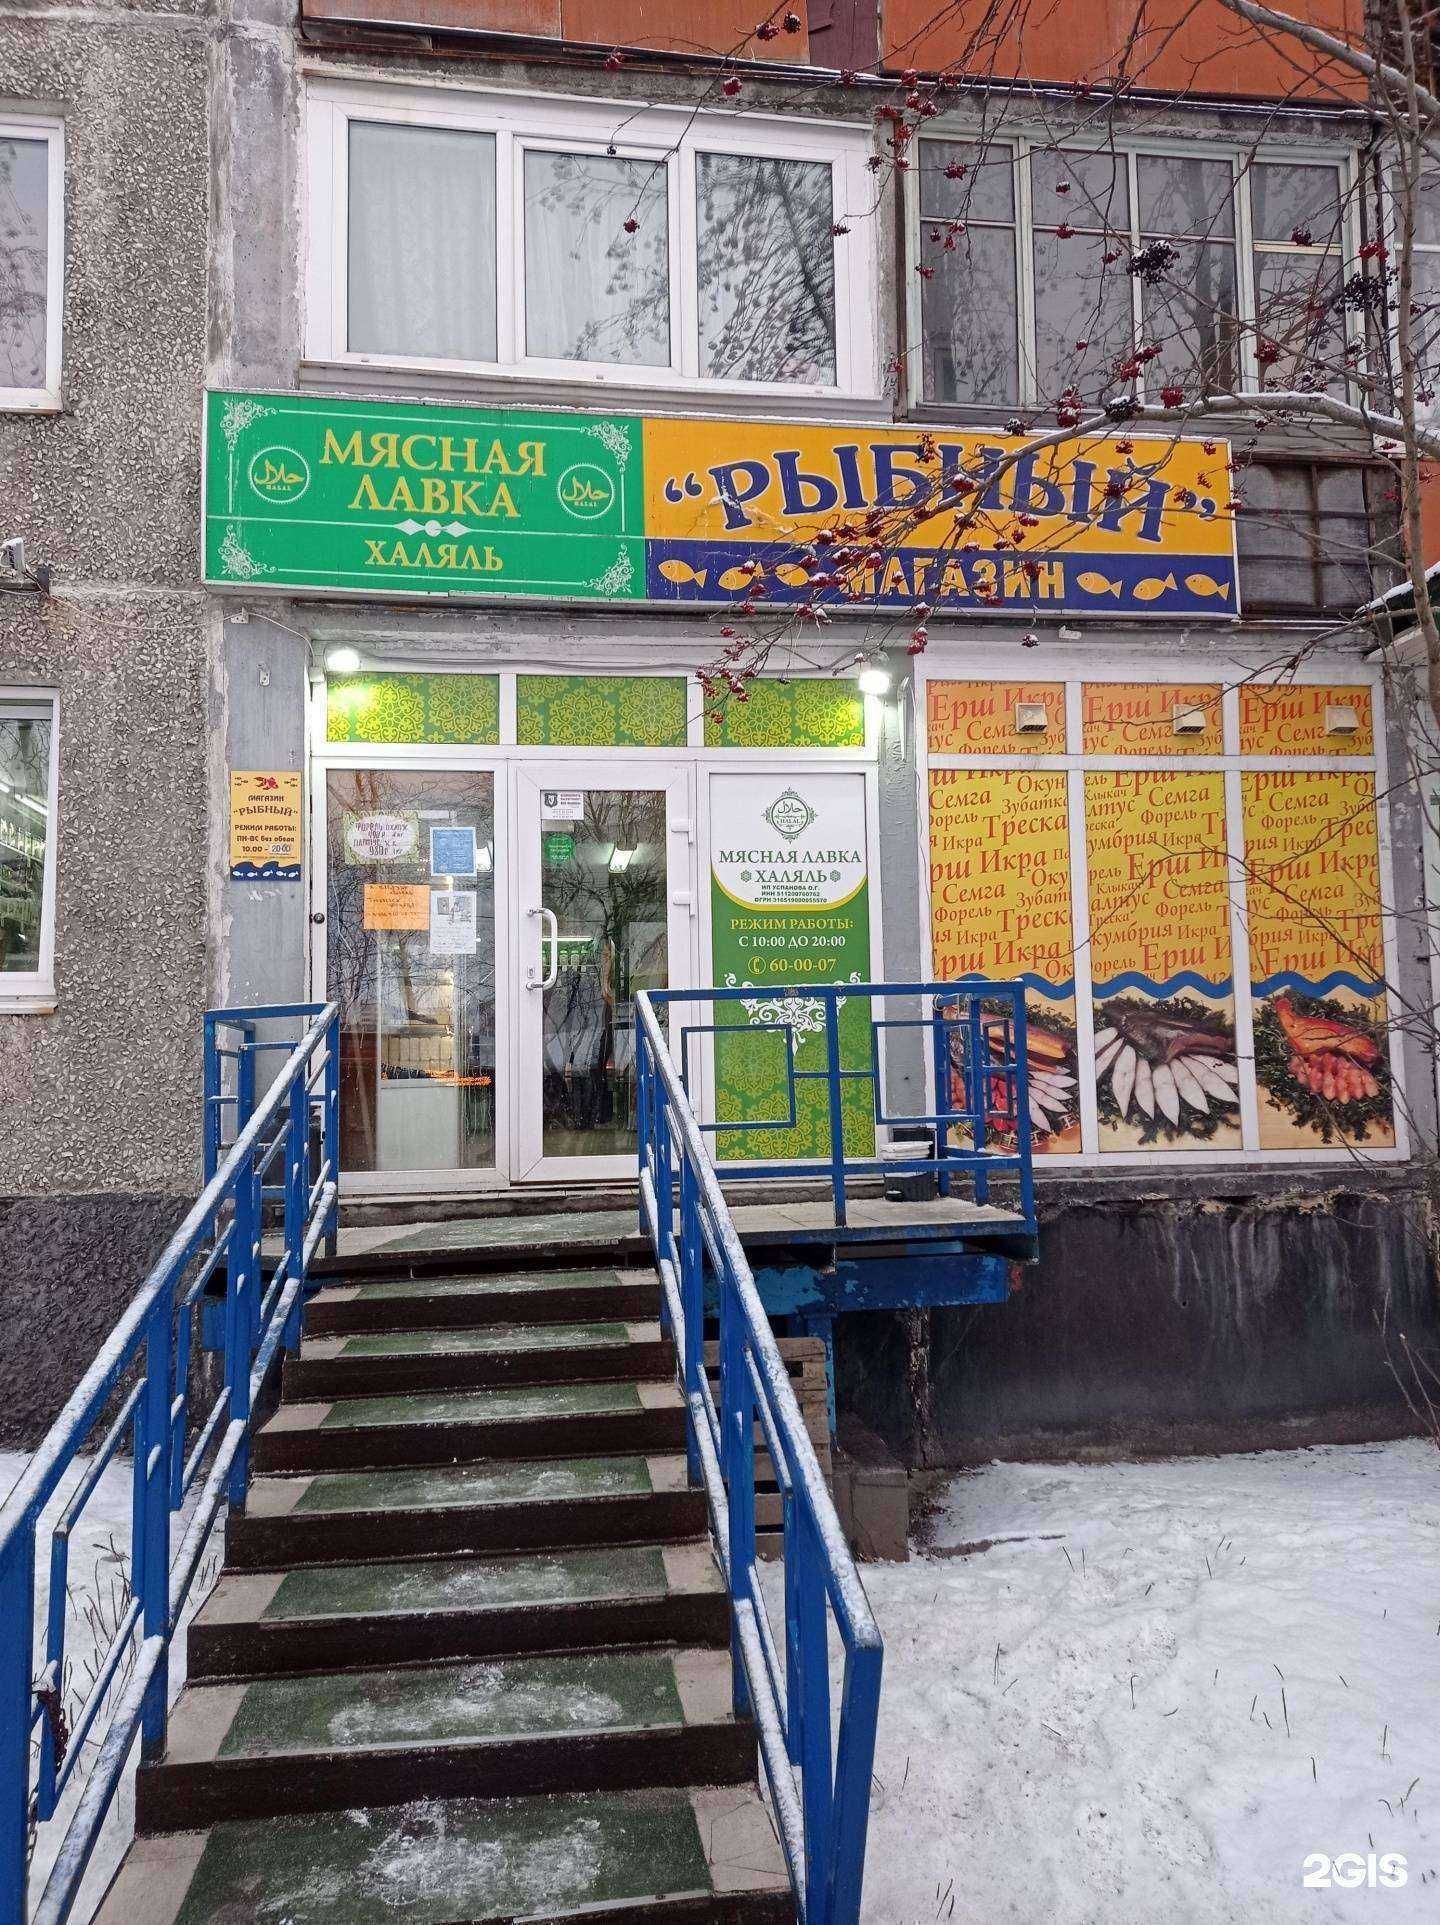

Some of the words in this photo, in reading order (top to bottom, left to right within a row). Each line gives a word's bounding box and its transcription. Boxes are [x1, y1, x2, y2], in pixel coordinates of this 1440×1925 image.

[319, 428, 547, 477] МЯСНАЯ
[347, 473, 522, 518] ЛАВКА
[364, 539, 504, 572] ХАЛЯЛЬ
[931, 694, 997, 731] Ерш
[1086, 696, 1152, 733] Ерш
[1242, 697, 1305, 733] Ерш
[967, 720, 1017, 741] Семг
[1122, 723, 1173, 742] Семг
[1277, 723, 1325, 742] Семг
[247, 794, 285, 802] МАГАЗИН
[929, 790, 992, 809] Семга
[1149, 786, 1210, 807] Семга
[1268, 791, 1329, 811] Семга
[264, 824, 297, 832] РАБОТЫ:
[1141, 810, 1197, 828] Форель
[1261, 813, 1316, 832] Форель
[982, 813, 1068, 846] Треска
[943, 835, 983, 853] Икра
[1163, 832, 1201, 849] Икра
[719, 850, 798, 863] МЯСНАЯ
[802, 850, 863, 863] ЛАВКА
[980, 848, 1048, 878] Икра
[755, 870, 828, 882] ХАЛЯЛЬ
[1126, 852, 1190, 889] Ерш
[1247, 858, 1311, 894] Ерш
[942, 883, 1007, 904] Семга
[1163, 878, 1225, 899] Семга
[1284, 883, 1344, 904] Семга
[934, 906, 992, 925] Форель
[1155, 902, 1212, 920] Форель
[730, 918, 786, 930] РЕЖИМ
[790, 918, 854, 930] РАБОТЫ:
[1178, 923, 1217, 942] Икра
[738, 936, 748, 947] С
[752, 936, 786, 947] 10:00
[788, 936, 808, 948] ДО
[812, 935, 846, 947] 20:00
[956, 930, 998, 948] Икра
[994, 939, 1061, 970] Икра
[1142, 943, 1206, 980] Ерш
[769, 958, 837, 972] 60-00-07
[1091, 957, 1136, 977] орель
